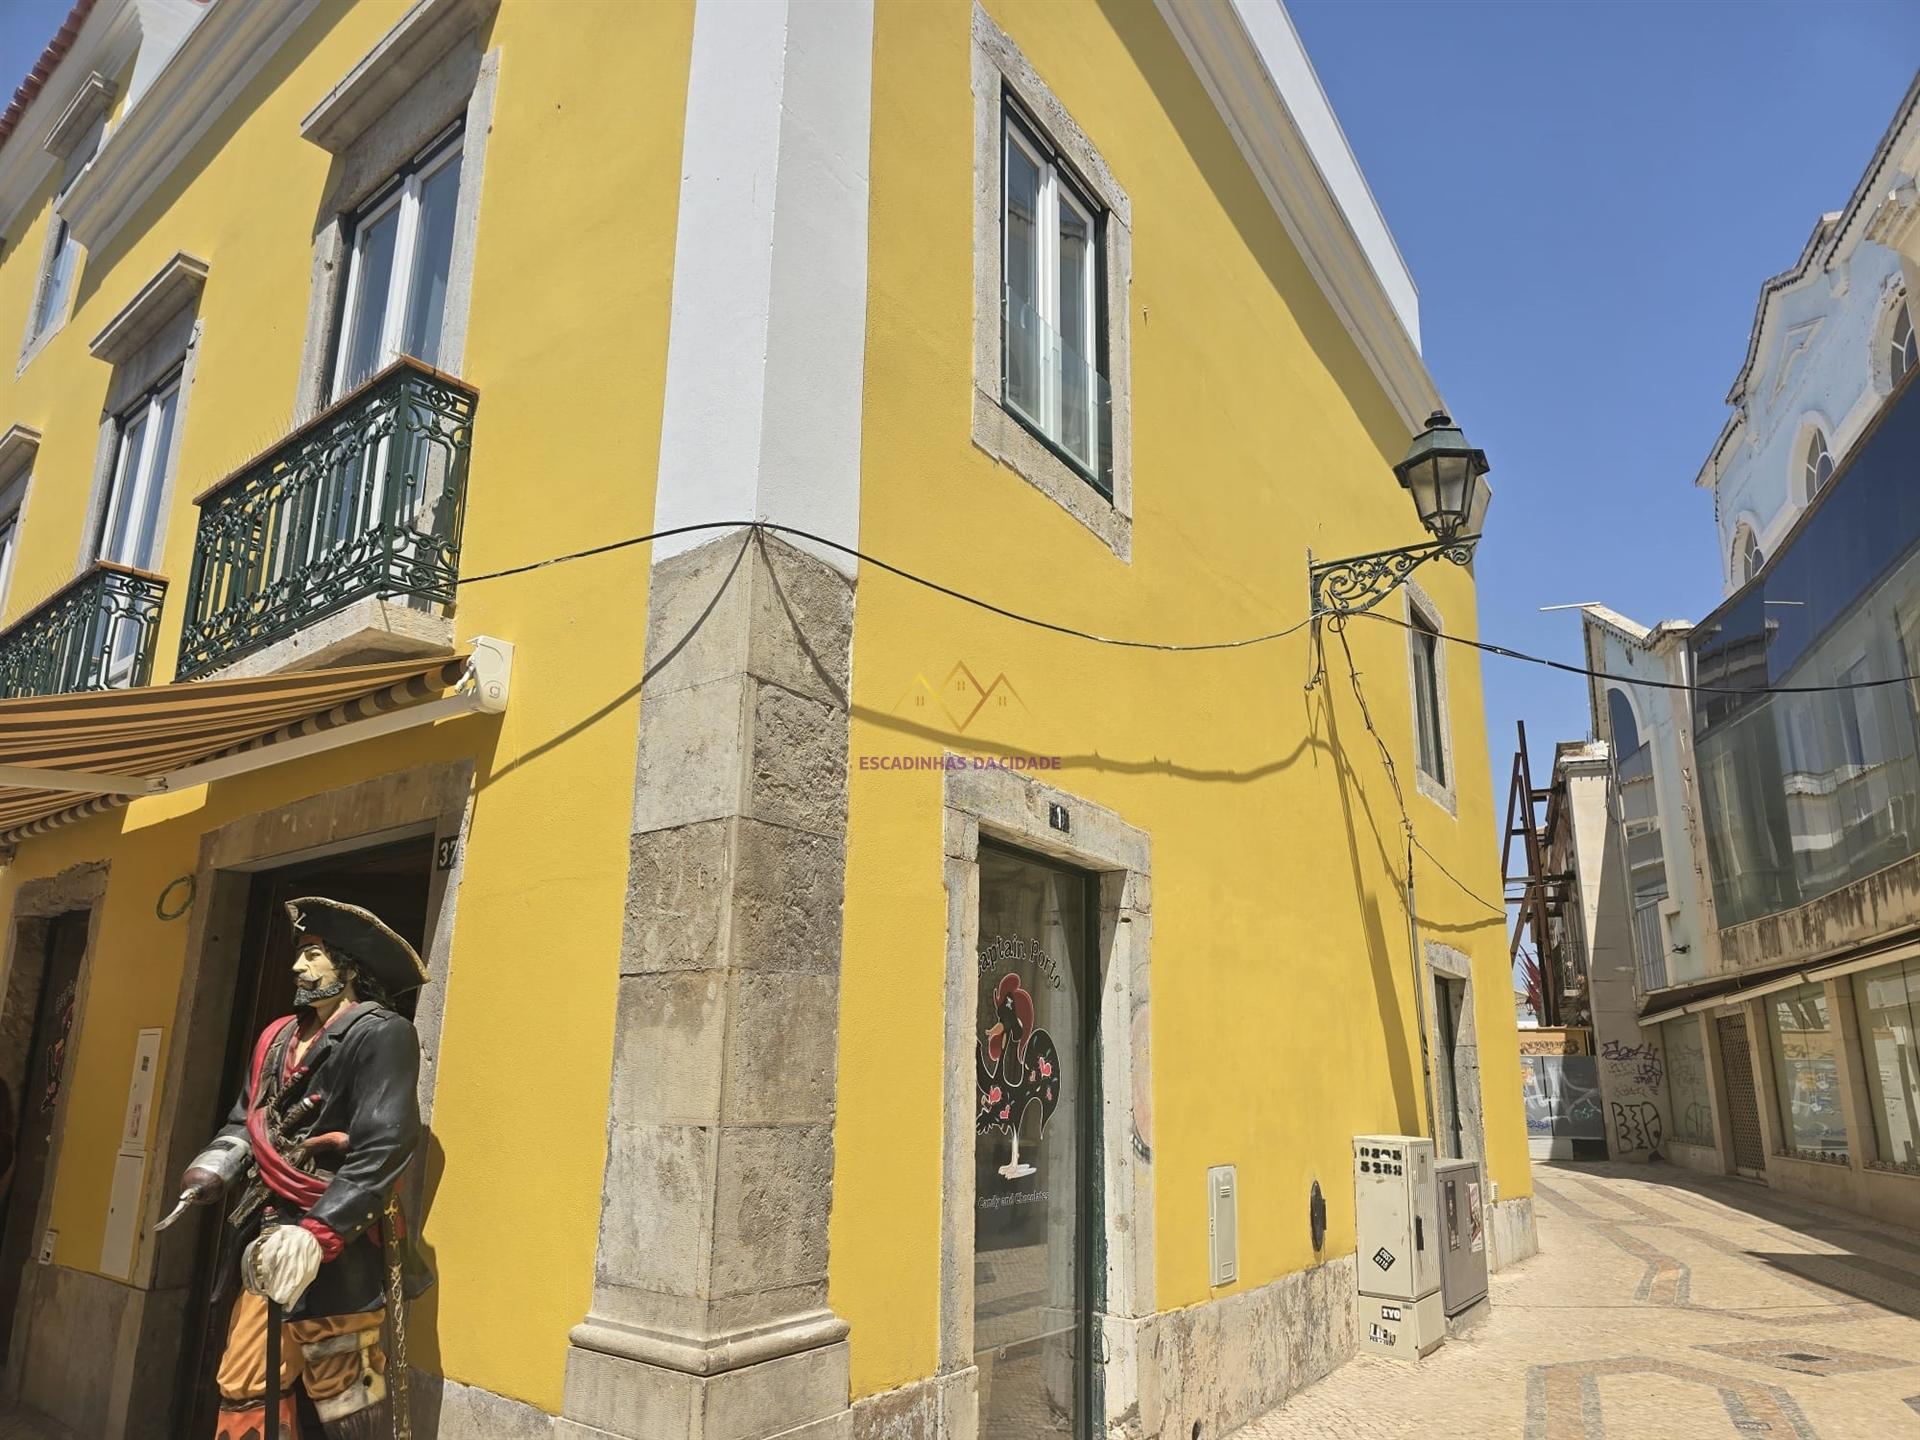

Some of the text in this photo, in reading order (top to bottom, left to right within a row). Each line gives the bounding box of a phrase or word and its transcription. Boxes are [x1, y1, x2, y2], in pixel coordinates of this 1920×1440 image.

[439, 840, 459, 867] 37
[1029, 938, 1061, 989] Porto
[1001, 1193, 1014, 1206] and
